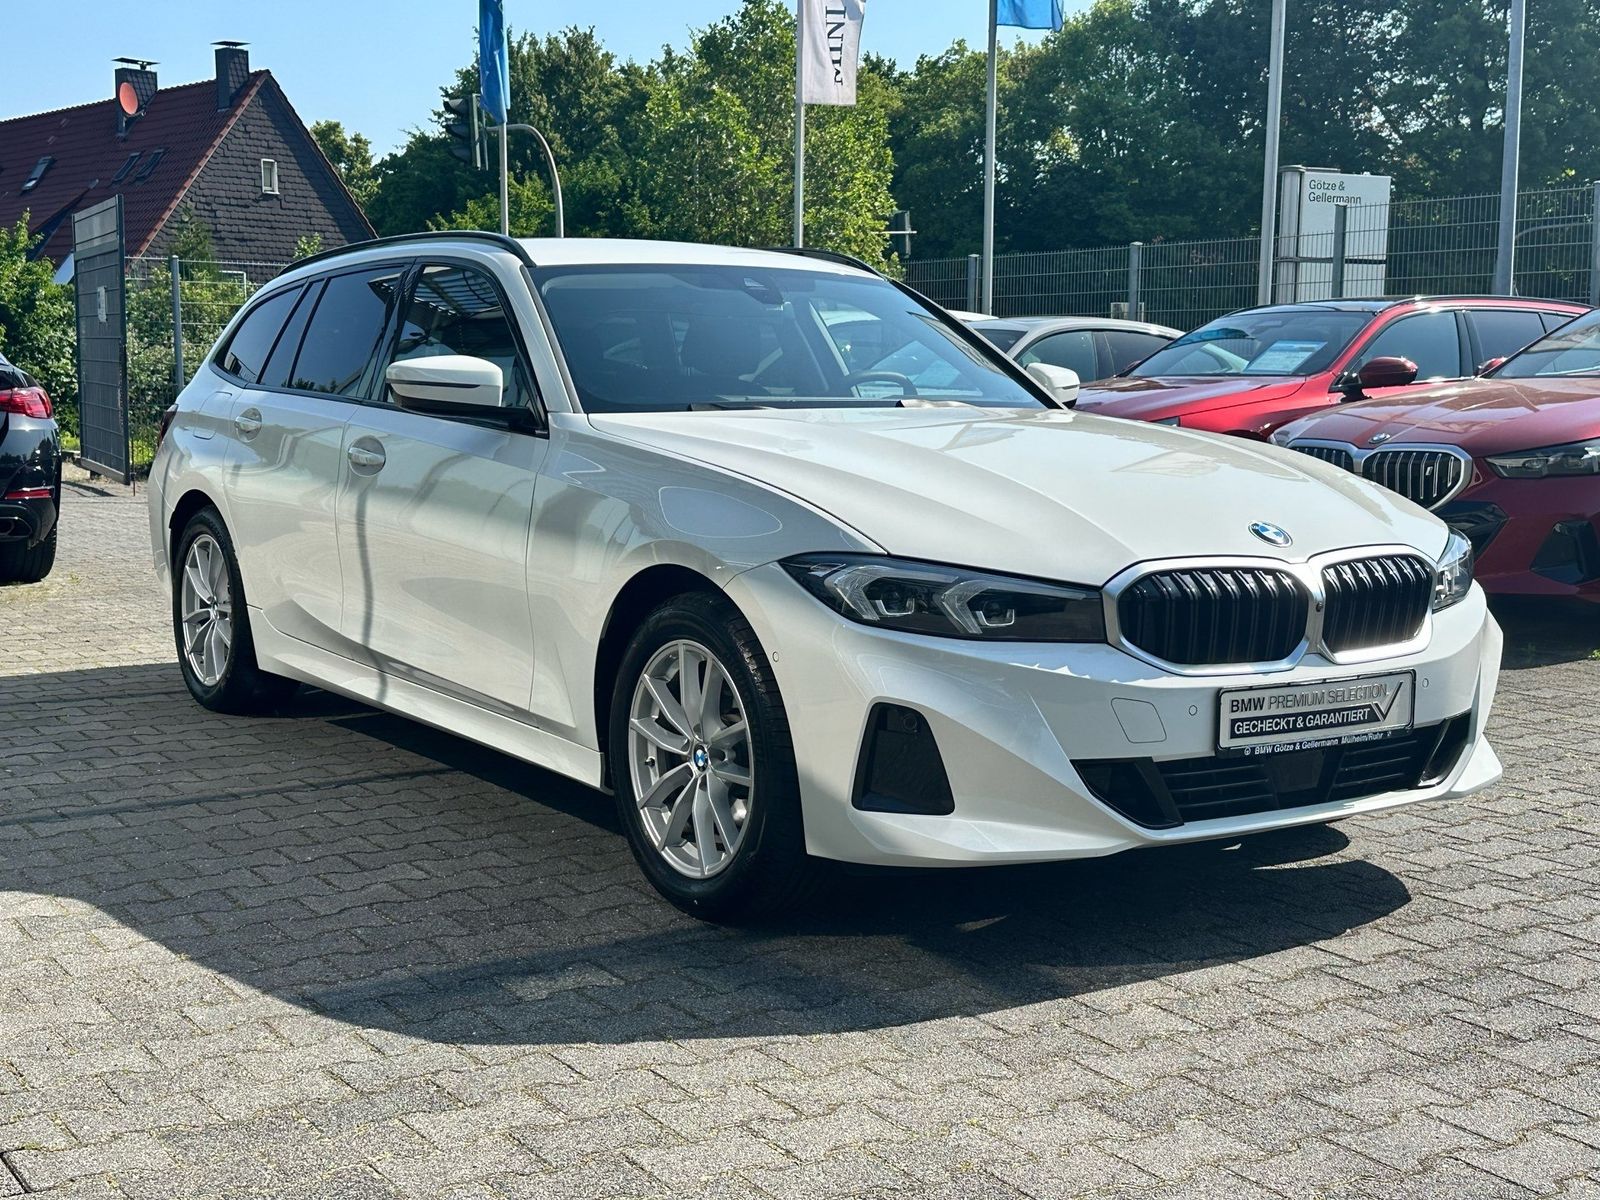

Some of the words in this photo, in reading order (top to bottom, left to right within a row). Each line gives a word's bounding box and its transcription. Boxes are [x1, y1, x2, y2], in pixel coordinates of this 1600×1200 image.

[825, 6, 846, 86] MINI
[1309, 179, 1337, 190] Götze
[1338, 181, 1345, 190] &
[1308, 192, 1362, 205] Gellermann
[1231, 697, 1265, 713] BMW
[1268, 692, 1325, 710] PREMIUM
[1234, 717, 1296, 735] GECHECKT
[1296, 716, 1304, 728] &
[1305, 708, 1371, 727] GARANTIERT
[1254, 745, 1273, 755] BMW
[1274, 743, 1294, 753] Götze
[1301, 738, 1339, 749] Gellermann
